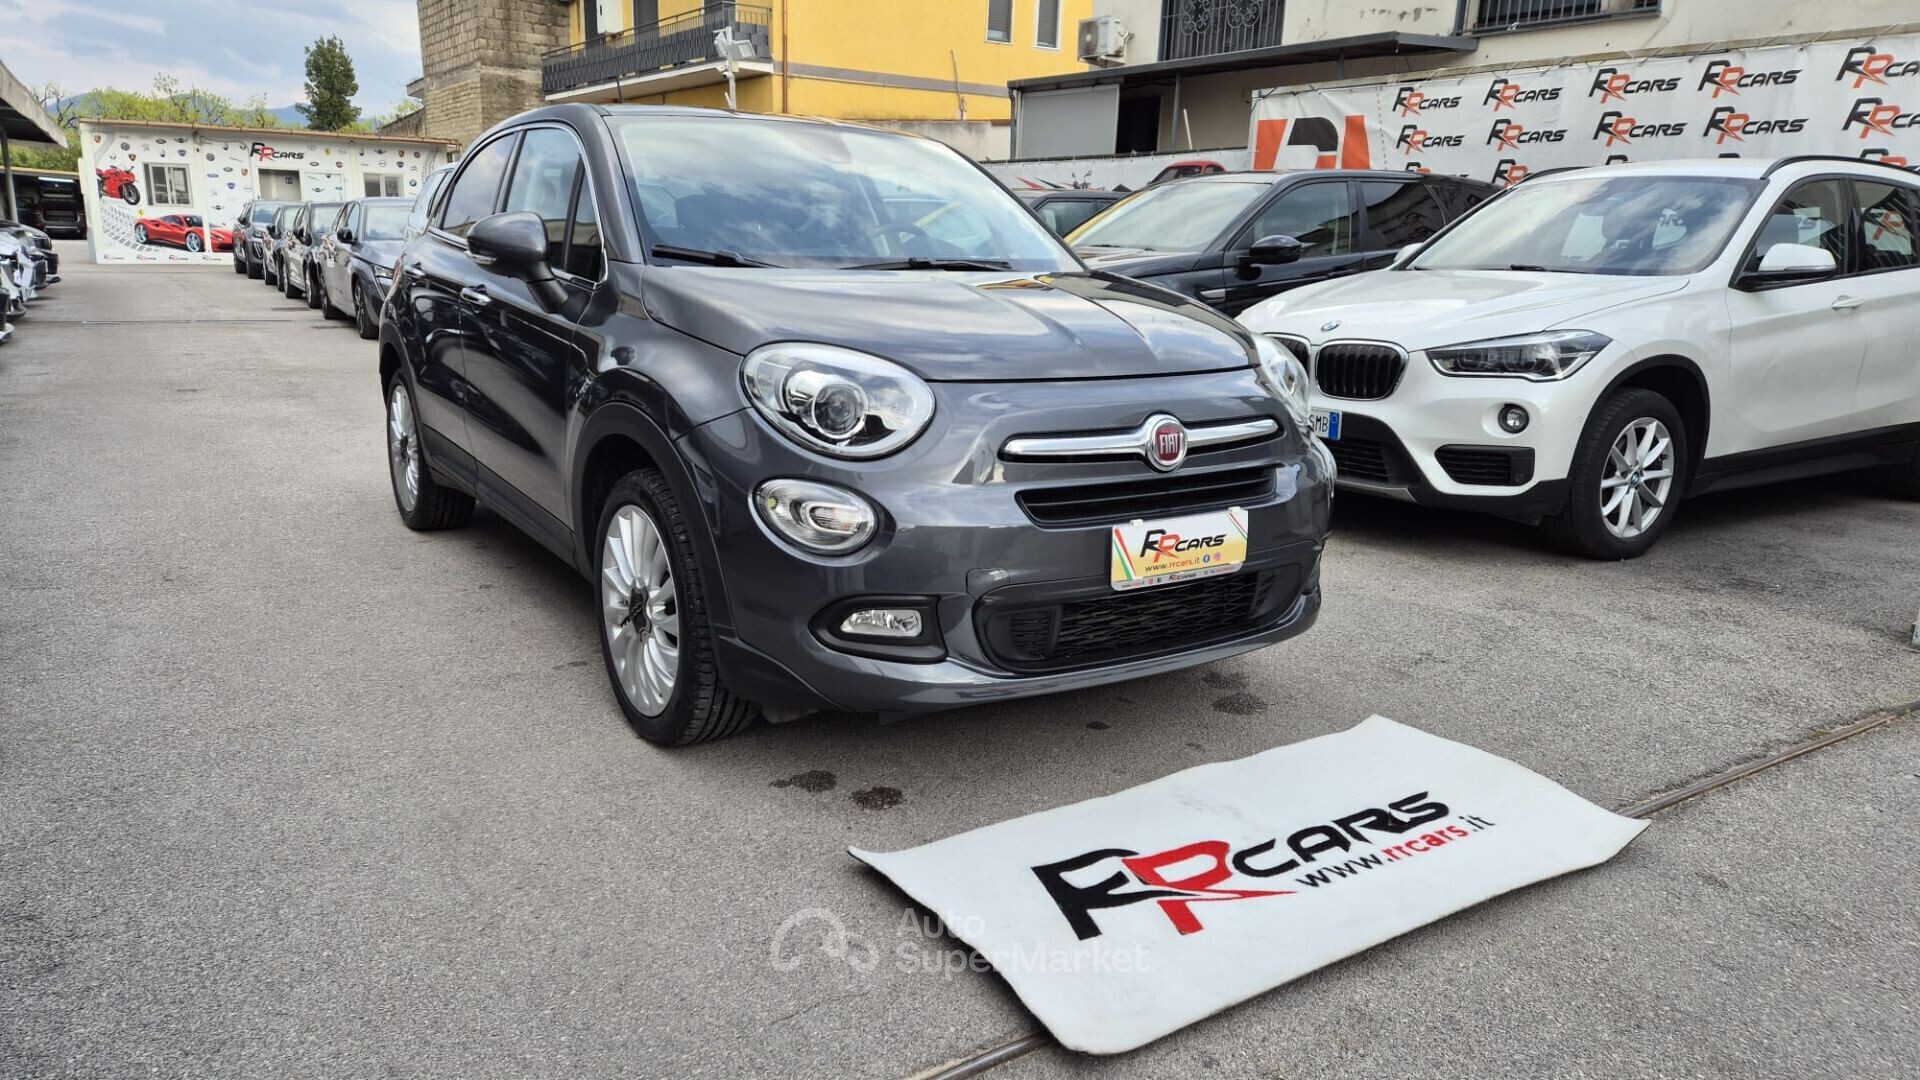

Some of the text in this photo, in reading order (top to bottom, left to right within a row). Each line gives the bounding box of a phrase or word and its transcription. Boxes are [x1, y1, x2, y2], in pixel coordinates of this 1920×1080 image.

[1835, 46, 1920, 88] RRCA
[1159, 432, 1180, 454] FIAT
[1145, 557, 1201, 572] www.rrcars.it
[1295, 814, 1496, 888] www.rrcars.it
